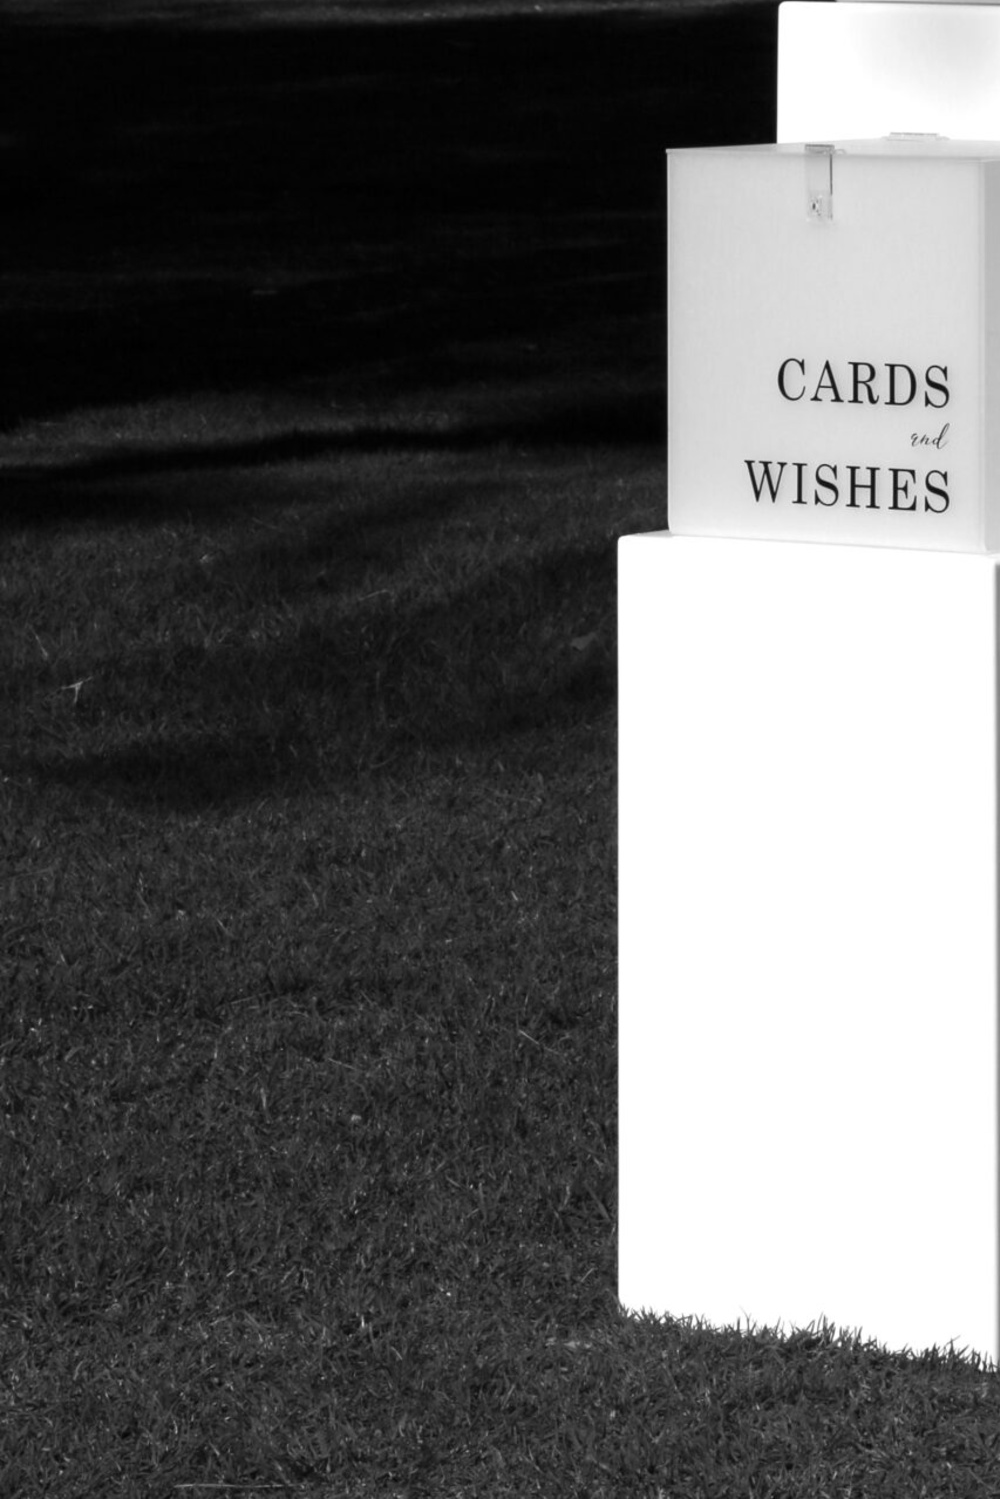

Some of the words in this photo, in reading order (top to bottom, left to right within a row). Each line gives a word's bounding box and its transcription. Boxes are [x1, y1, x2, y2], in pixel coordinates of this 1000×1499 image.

[776, 357, 951, 409] CARDS
[910, 422, 950, 450] and
[743, 459, 951, 515] WISHES
